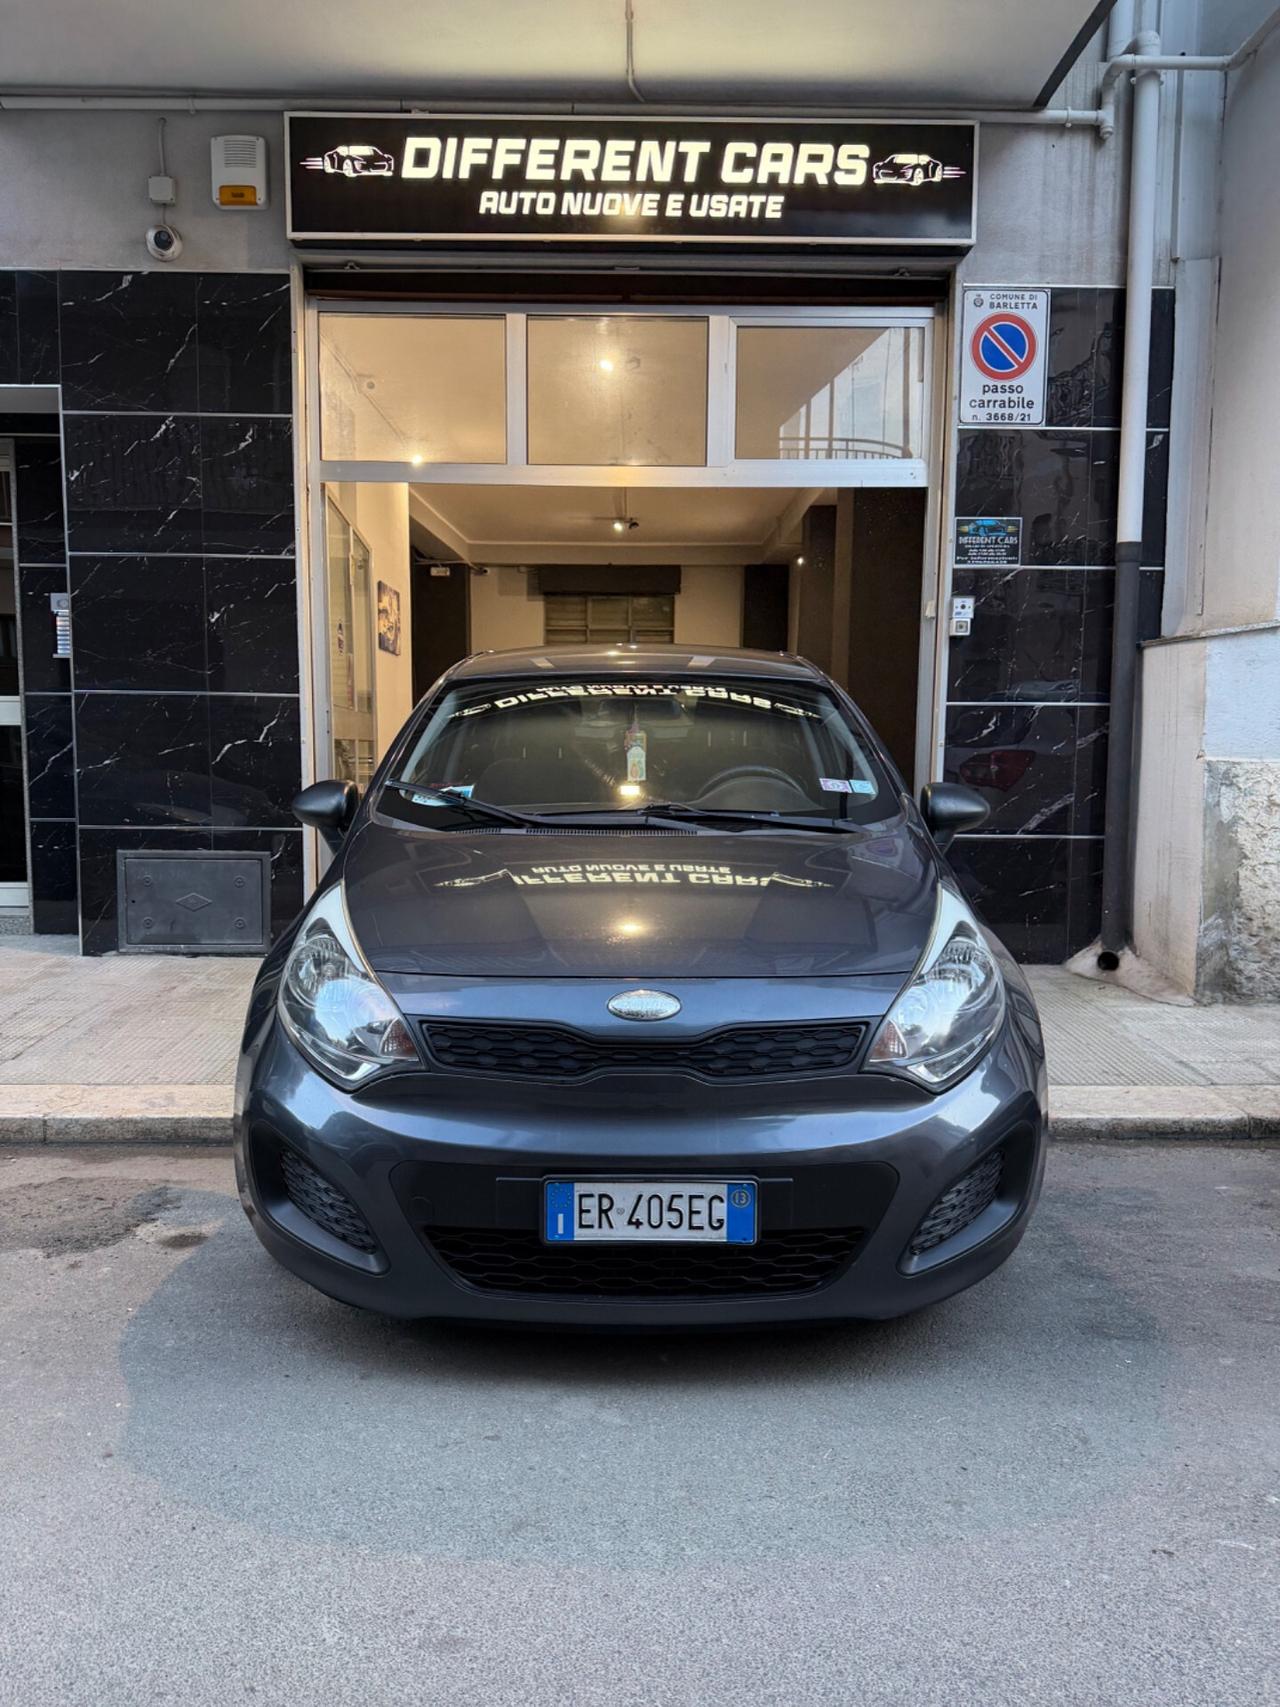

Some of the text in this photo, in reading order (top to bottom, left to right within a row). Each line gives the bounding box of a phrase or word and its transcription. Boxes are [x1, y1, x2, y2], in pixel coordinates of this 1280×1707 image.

[401, 136, 870, 186] DIFFERENT CARS
[478, 191, 785, 219] AUTO NUOVE E USATE
[990, 293, 1025, 301] COMUNE
[989, 302, 1039, 310] BARLETTA
[982, 384, 1024, 395] passo
[969, 397, 1035, 410] carrabile
[972, 413, 1031, 422] n. 3668/21
[734, 1193, 747, 1204] 13
[578, 1193, 725, 1231] ER 405EG
[557, 1213, 564, 1234] I
